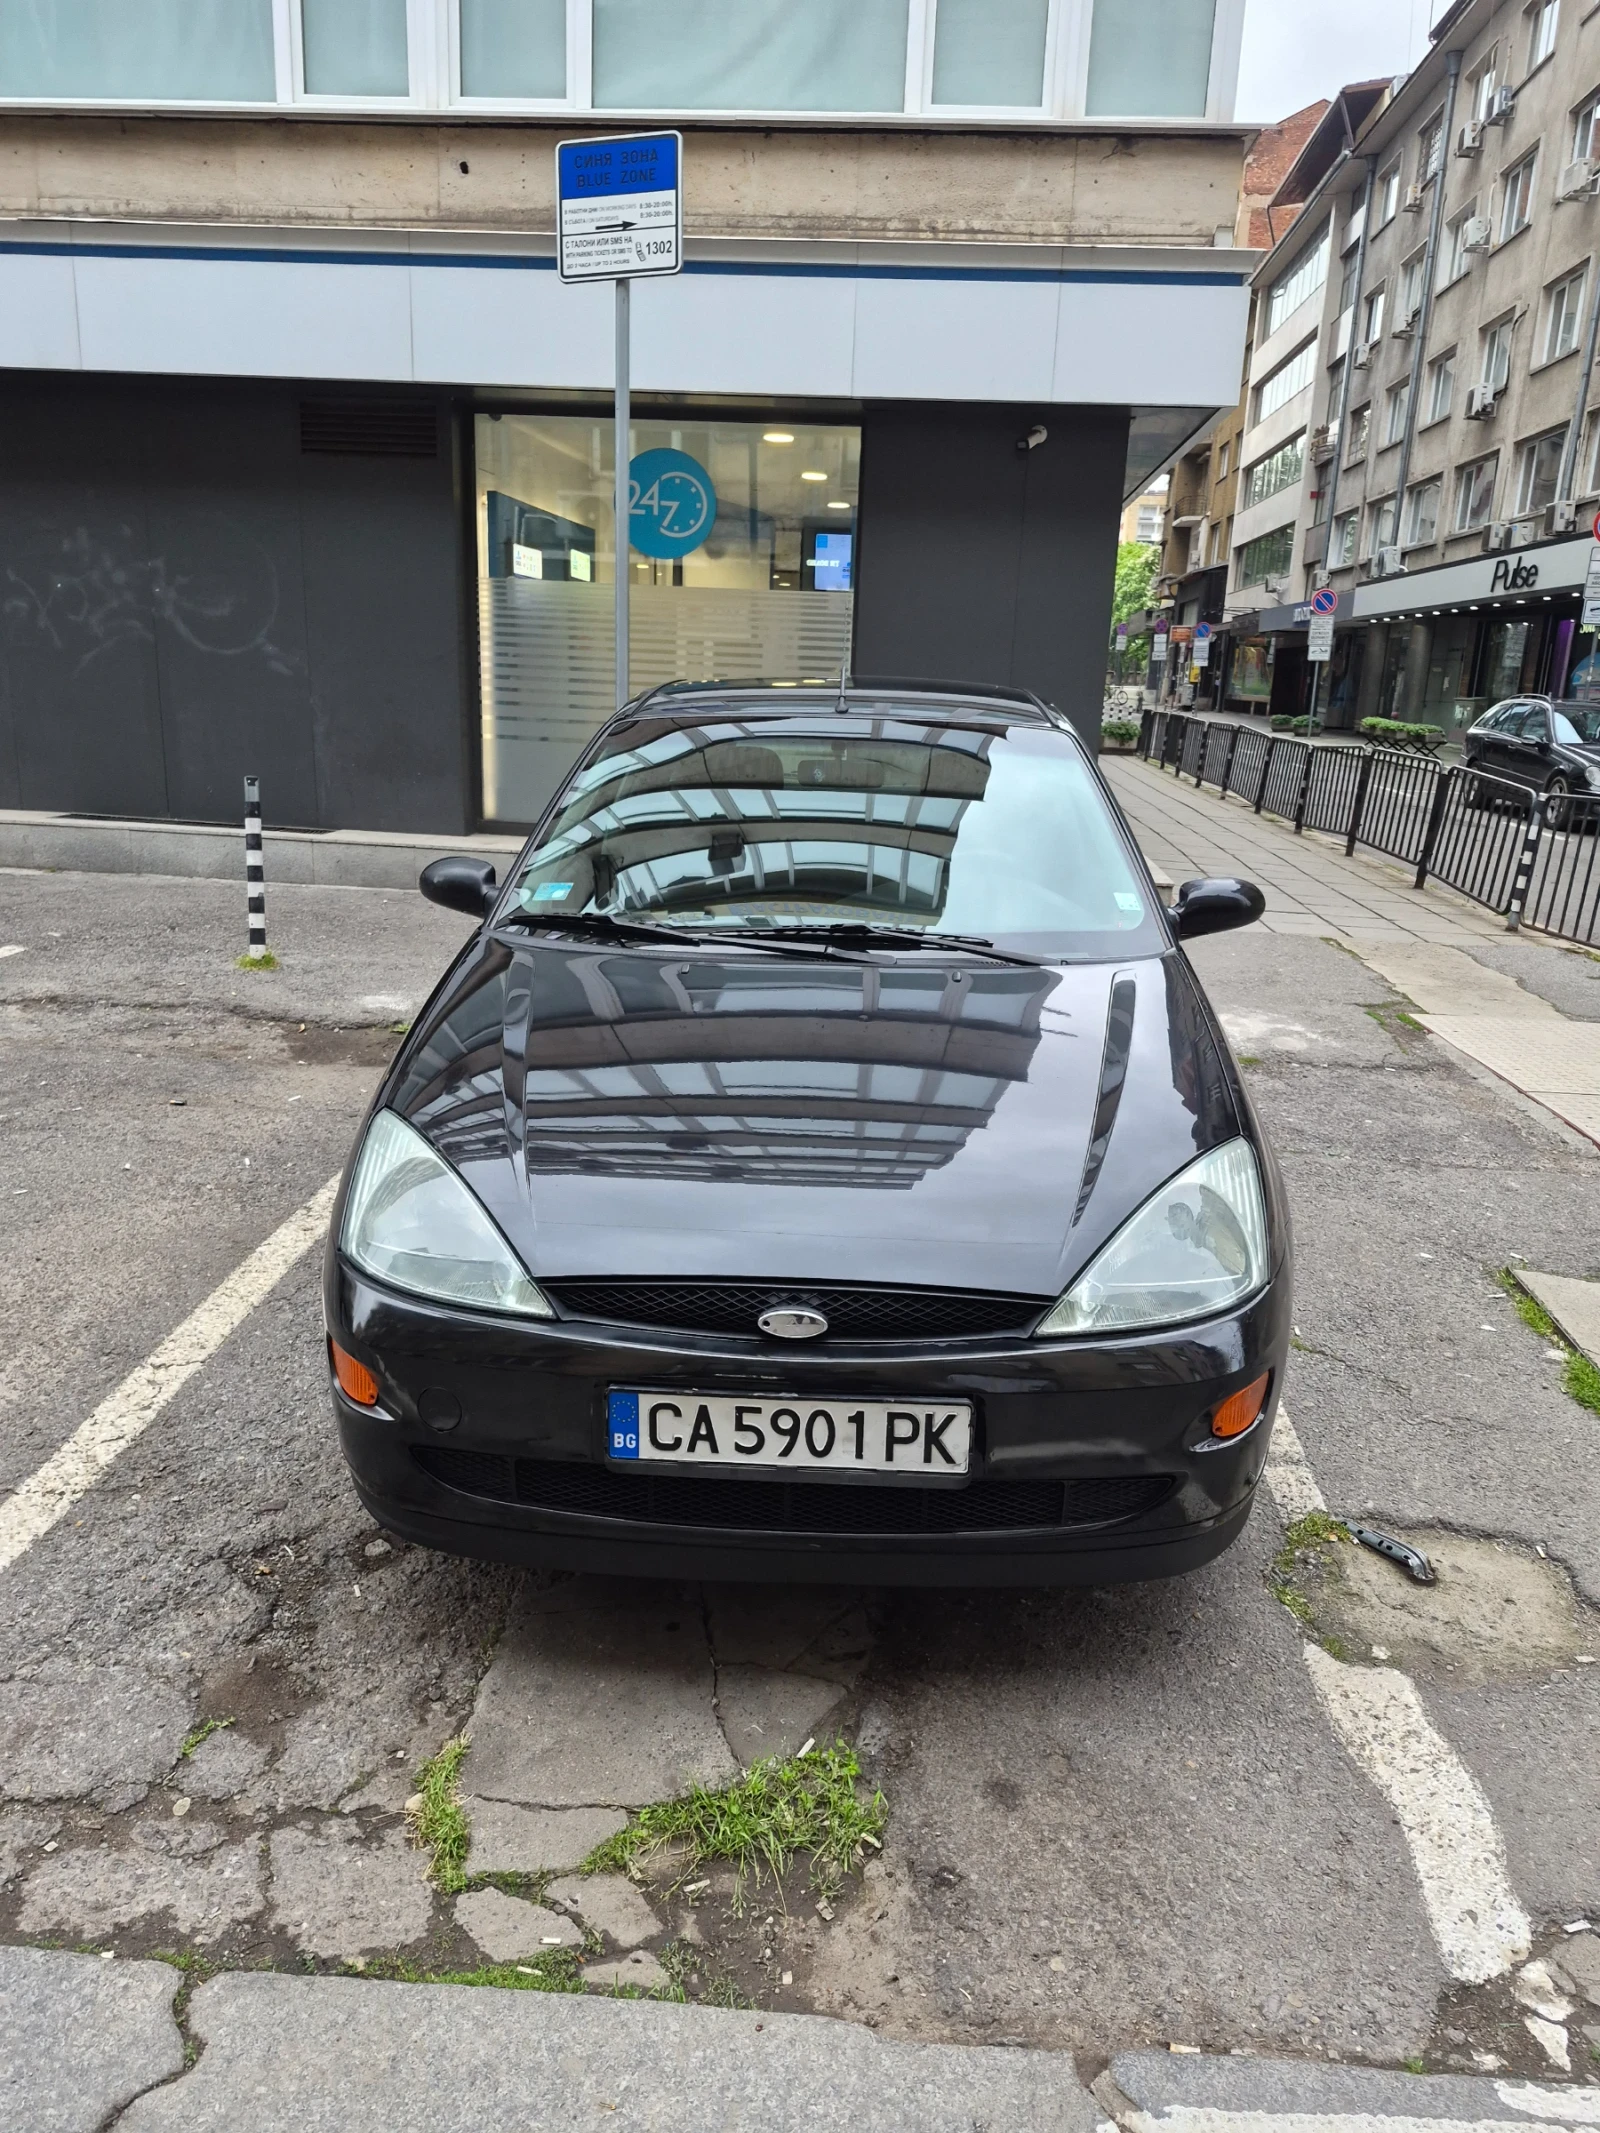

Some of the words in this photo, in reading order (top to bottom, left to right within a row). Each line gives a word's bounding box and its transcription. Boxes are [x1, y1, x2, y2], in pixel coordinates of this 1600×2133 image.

[574, 152, 612, 168] СИНЯ
[621, 148, 658, 164] ЗОНА
[577, 172, 611, 188] BLUE
[621, 168, 656, 184] ZONE
[565, 241, 570, 249] С
[571, 239, 596, 248] ТАЛОНИ
[596, 238, 609, 246] ИЛИ
[610, 236, 623, 245] SMS
[624, 236, 633, 244] НА
[645, 240, 673, 255] 1302
[660, 500, 681, 528] 7
[1490, 556, 1539, 593] Pulse
[613, 1433, 637, 1450] BG
